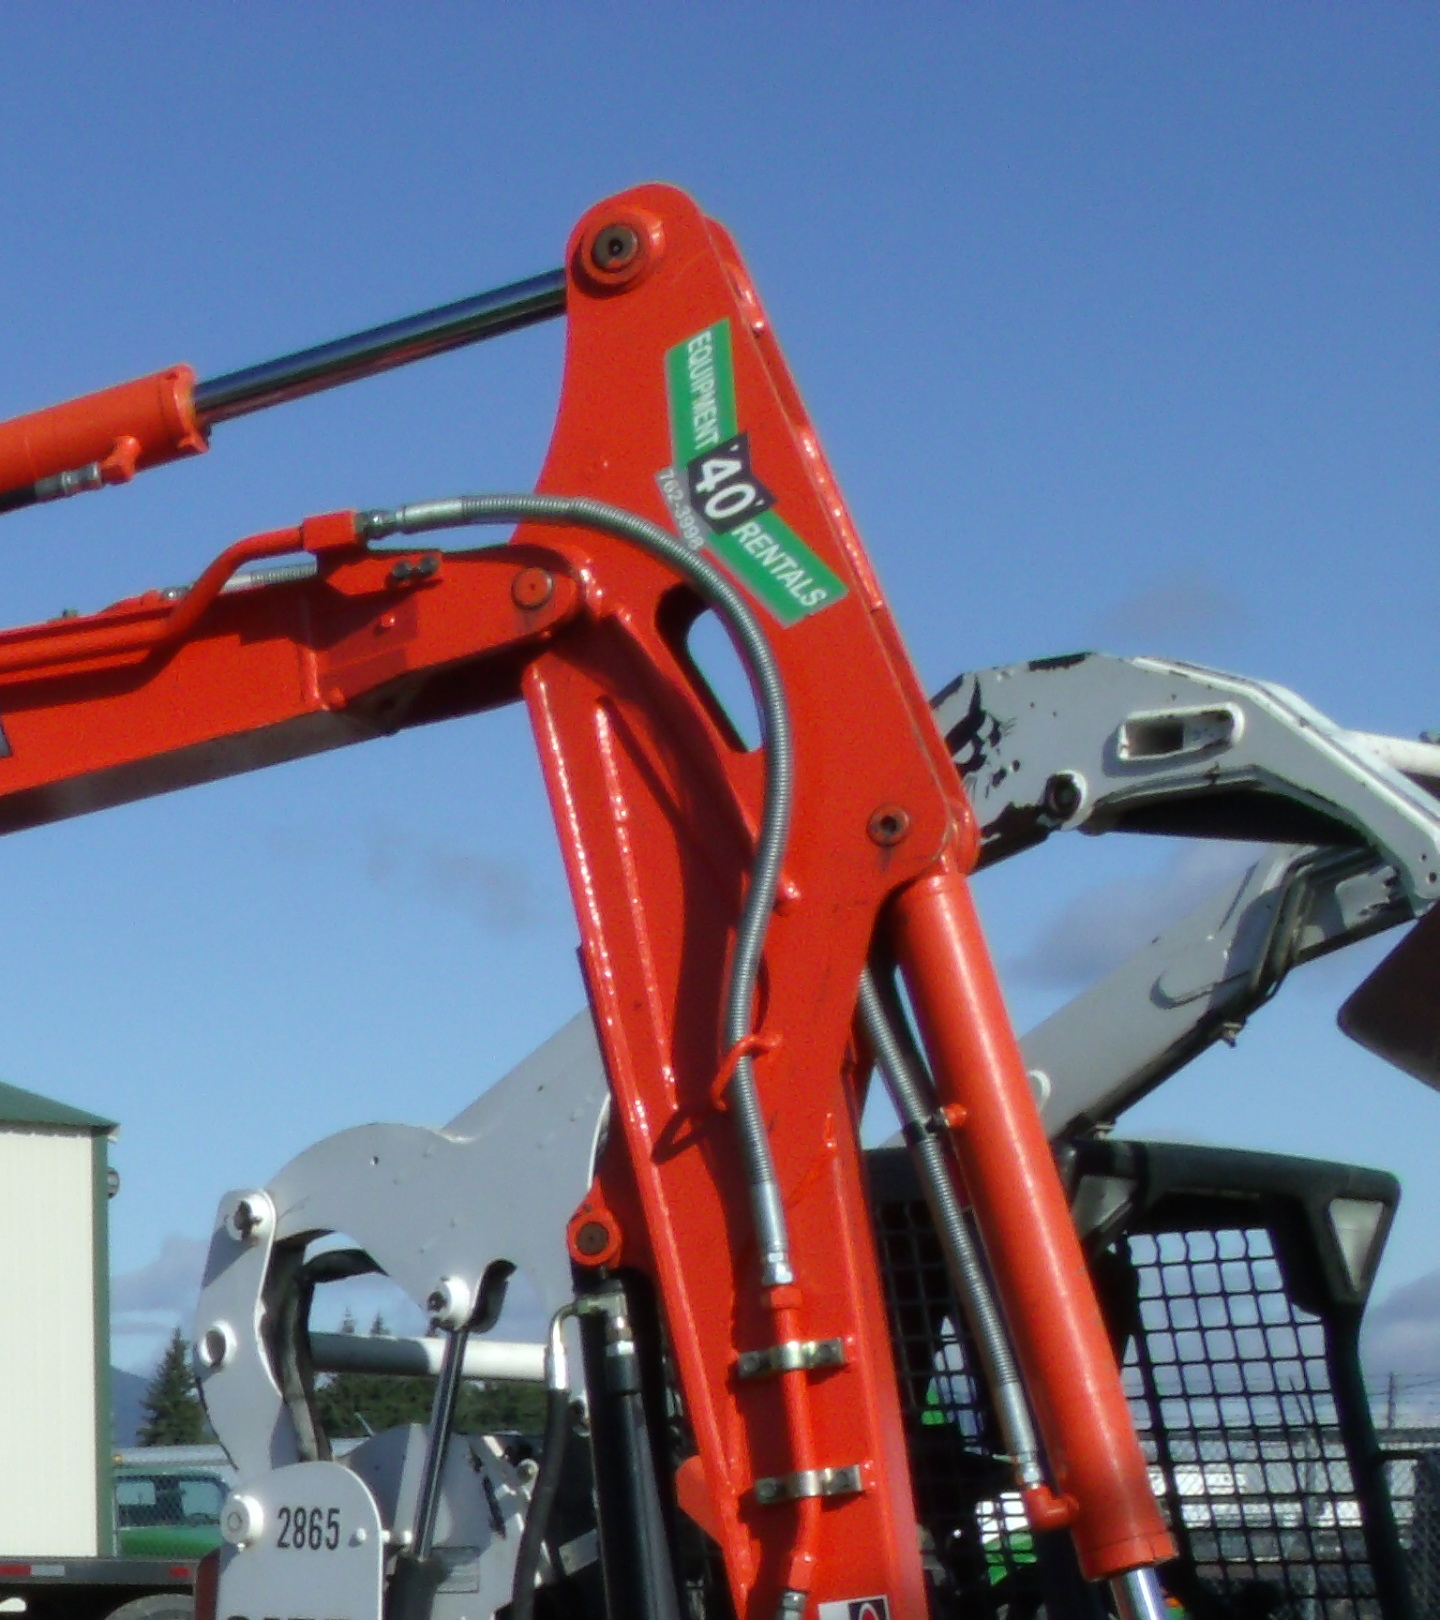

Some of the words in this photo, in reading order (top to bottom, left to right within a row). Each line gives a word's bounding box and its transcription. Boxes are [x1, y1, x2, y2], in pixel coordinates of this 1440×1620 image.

[658, 469, 704, 550] 762-3998
[687, 330, 720, 449] EQUIPMENT
[731, 521, 829, 609] RENTALS
[278, 1506, 340, 1550] 2865
